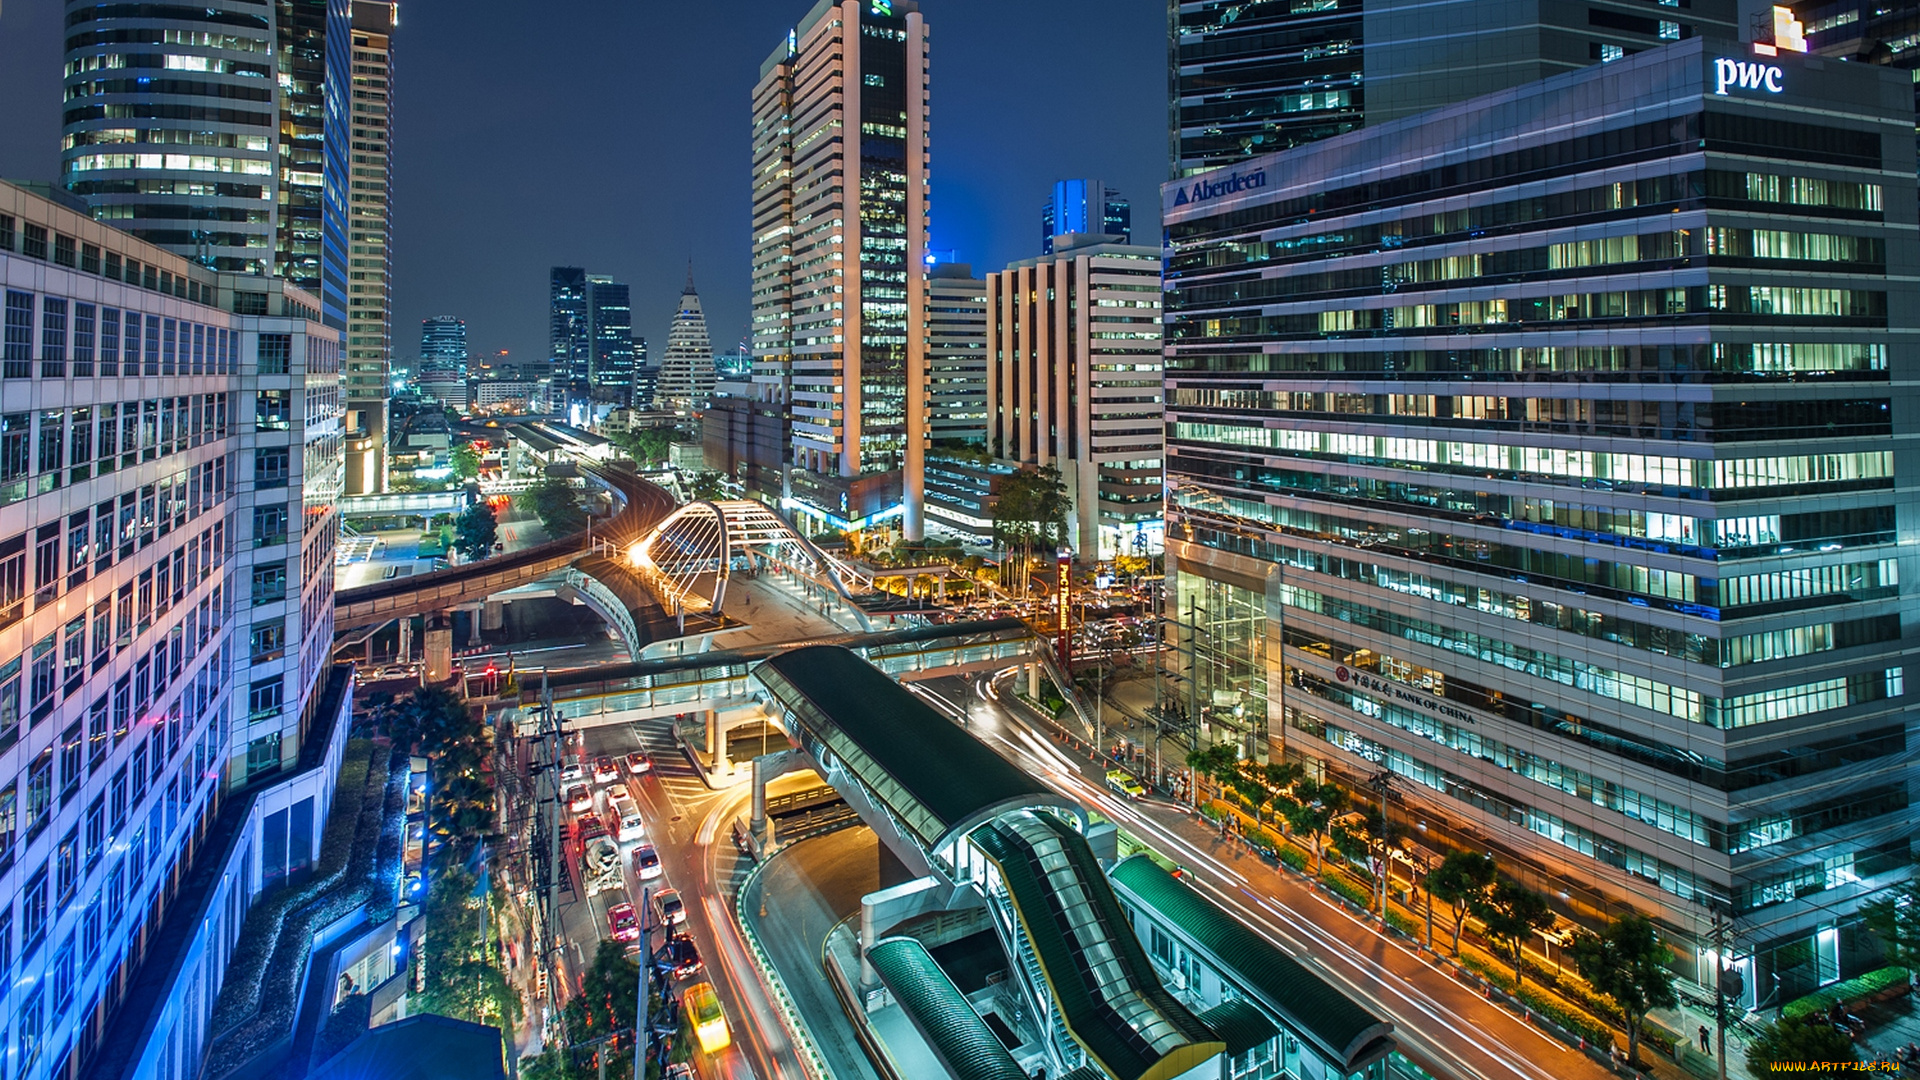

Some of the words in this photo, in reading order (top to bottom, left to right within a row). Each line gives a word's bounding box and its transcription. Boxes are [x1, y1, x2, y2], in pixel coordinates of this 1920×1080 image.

[1714, 58, 1783, 95] pwc
[1191, 171, 1266, 202] Aberdeen
[1395, 690, 1423, 707] BANK
[1423, 700, 1438, 711] OF
[1439, 706, 1475, 725] CHINA
